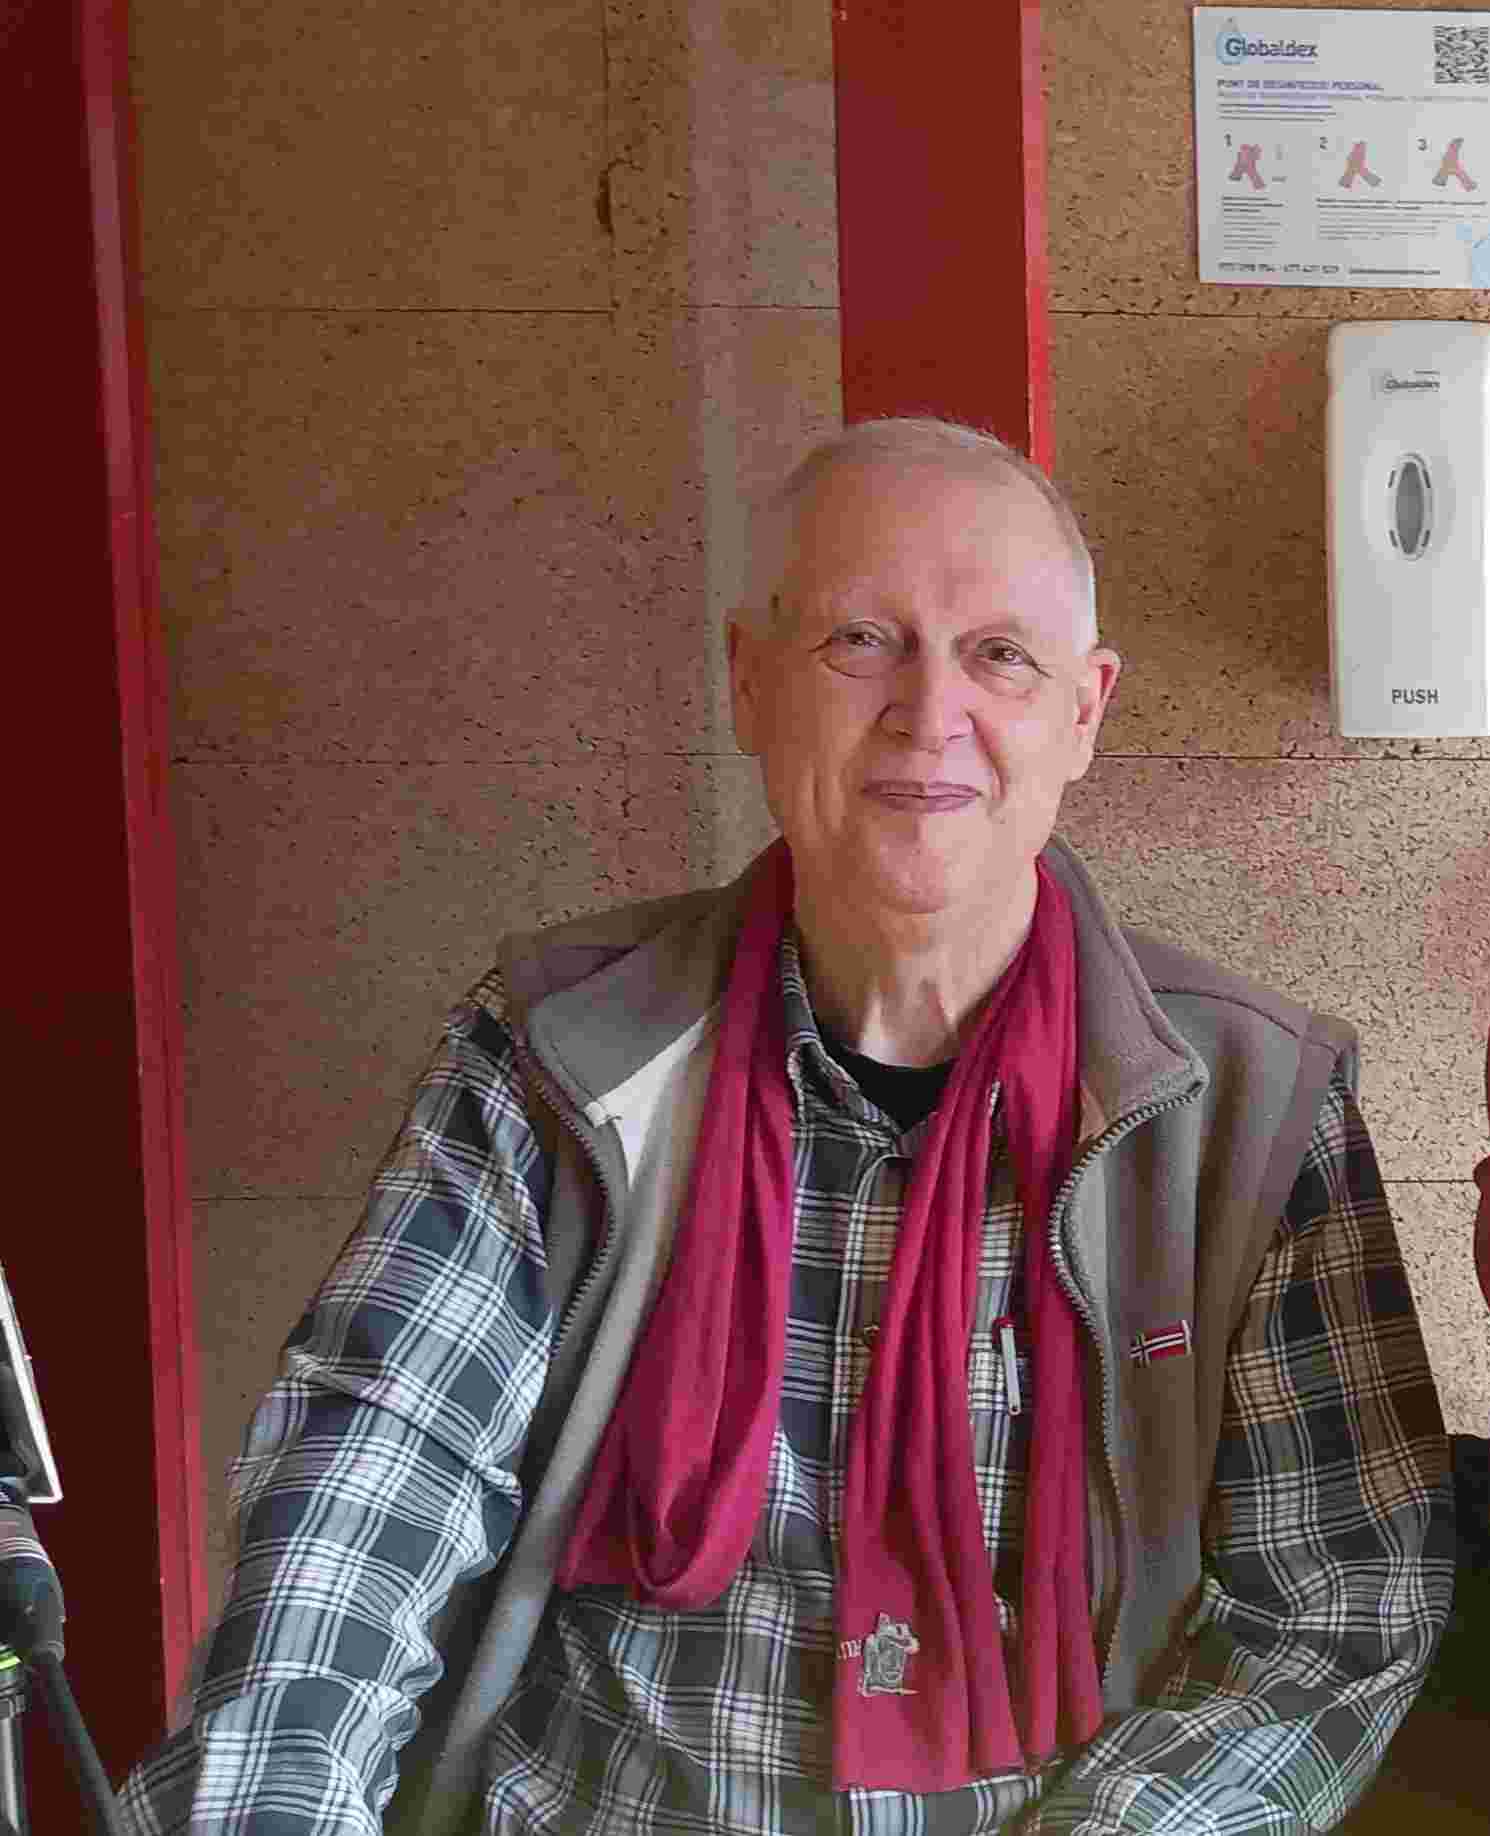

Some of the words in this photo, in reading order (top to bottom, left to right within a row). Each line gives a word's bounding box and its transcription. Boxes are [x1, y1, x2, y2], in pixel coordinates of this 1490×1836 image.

[1225, 37, 1319, 57] Globaldex
[1224, 133, 1232, 147] 1
[1319, 136, 1329, 150] 2
[1417, 138, 1428, 151] 3
[1391, 688, 1439, 705] PUSH
